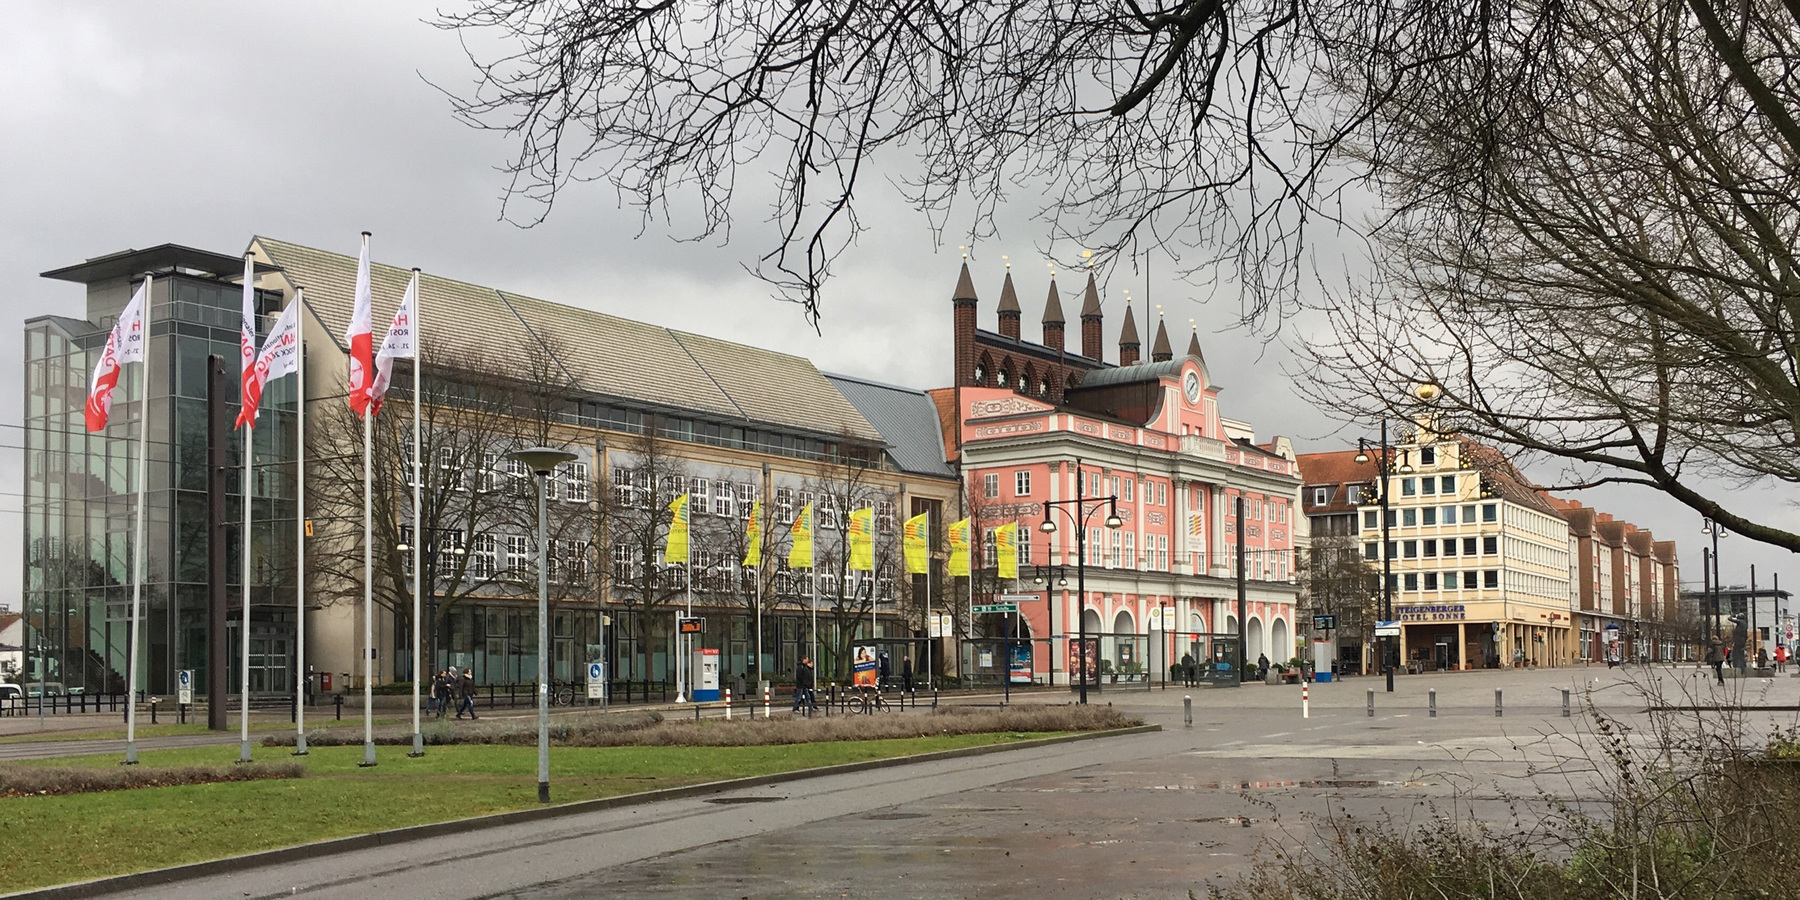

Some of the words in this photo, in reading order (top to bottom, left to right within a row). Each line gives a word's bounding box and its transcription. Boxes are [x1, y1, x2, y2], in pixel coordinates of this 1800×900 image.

[1395, 605, 1465, 614] STEIGENBERGER
[1395, 613, 1428, 621] HOTEL
[1433, 612, 1466, 620] SONNE
